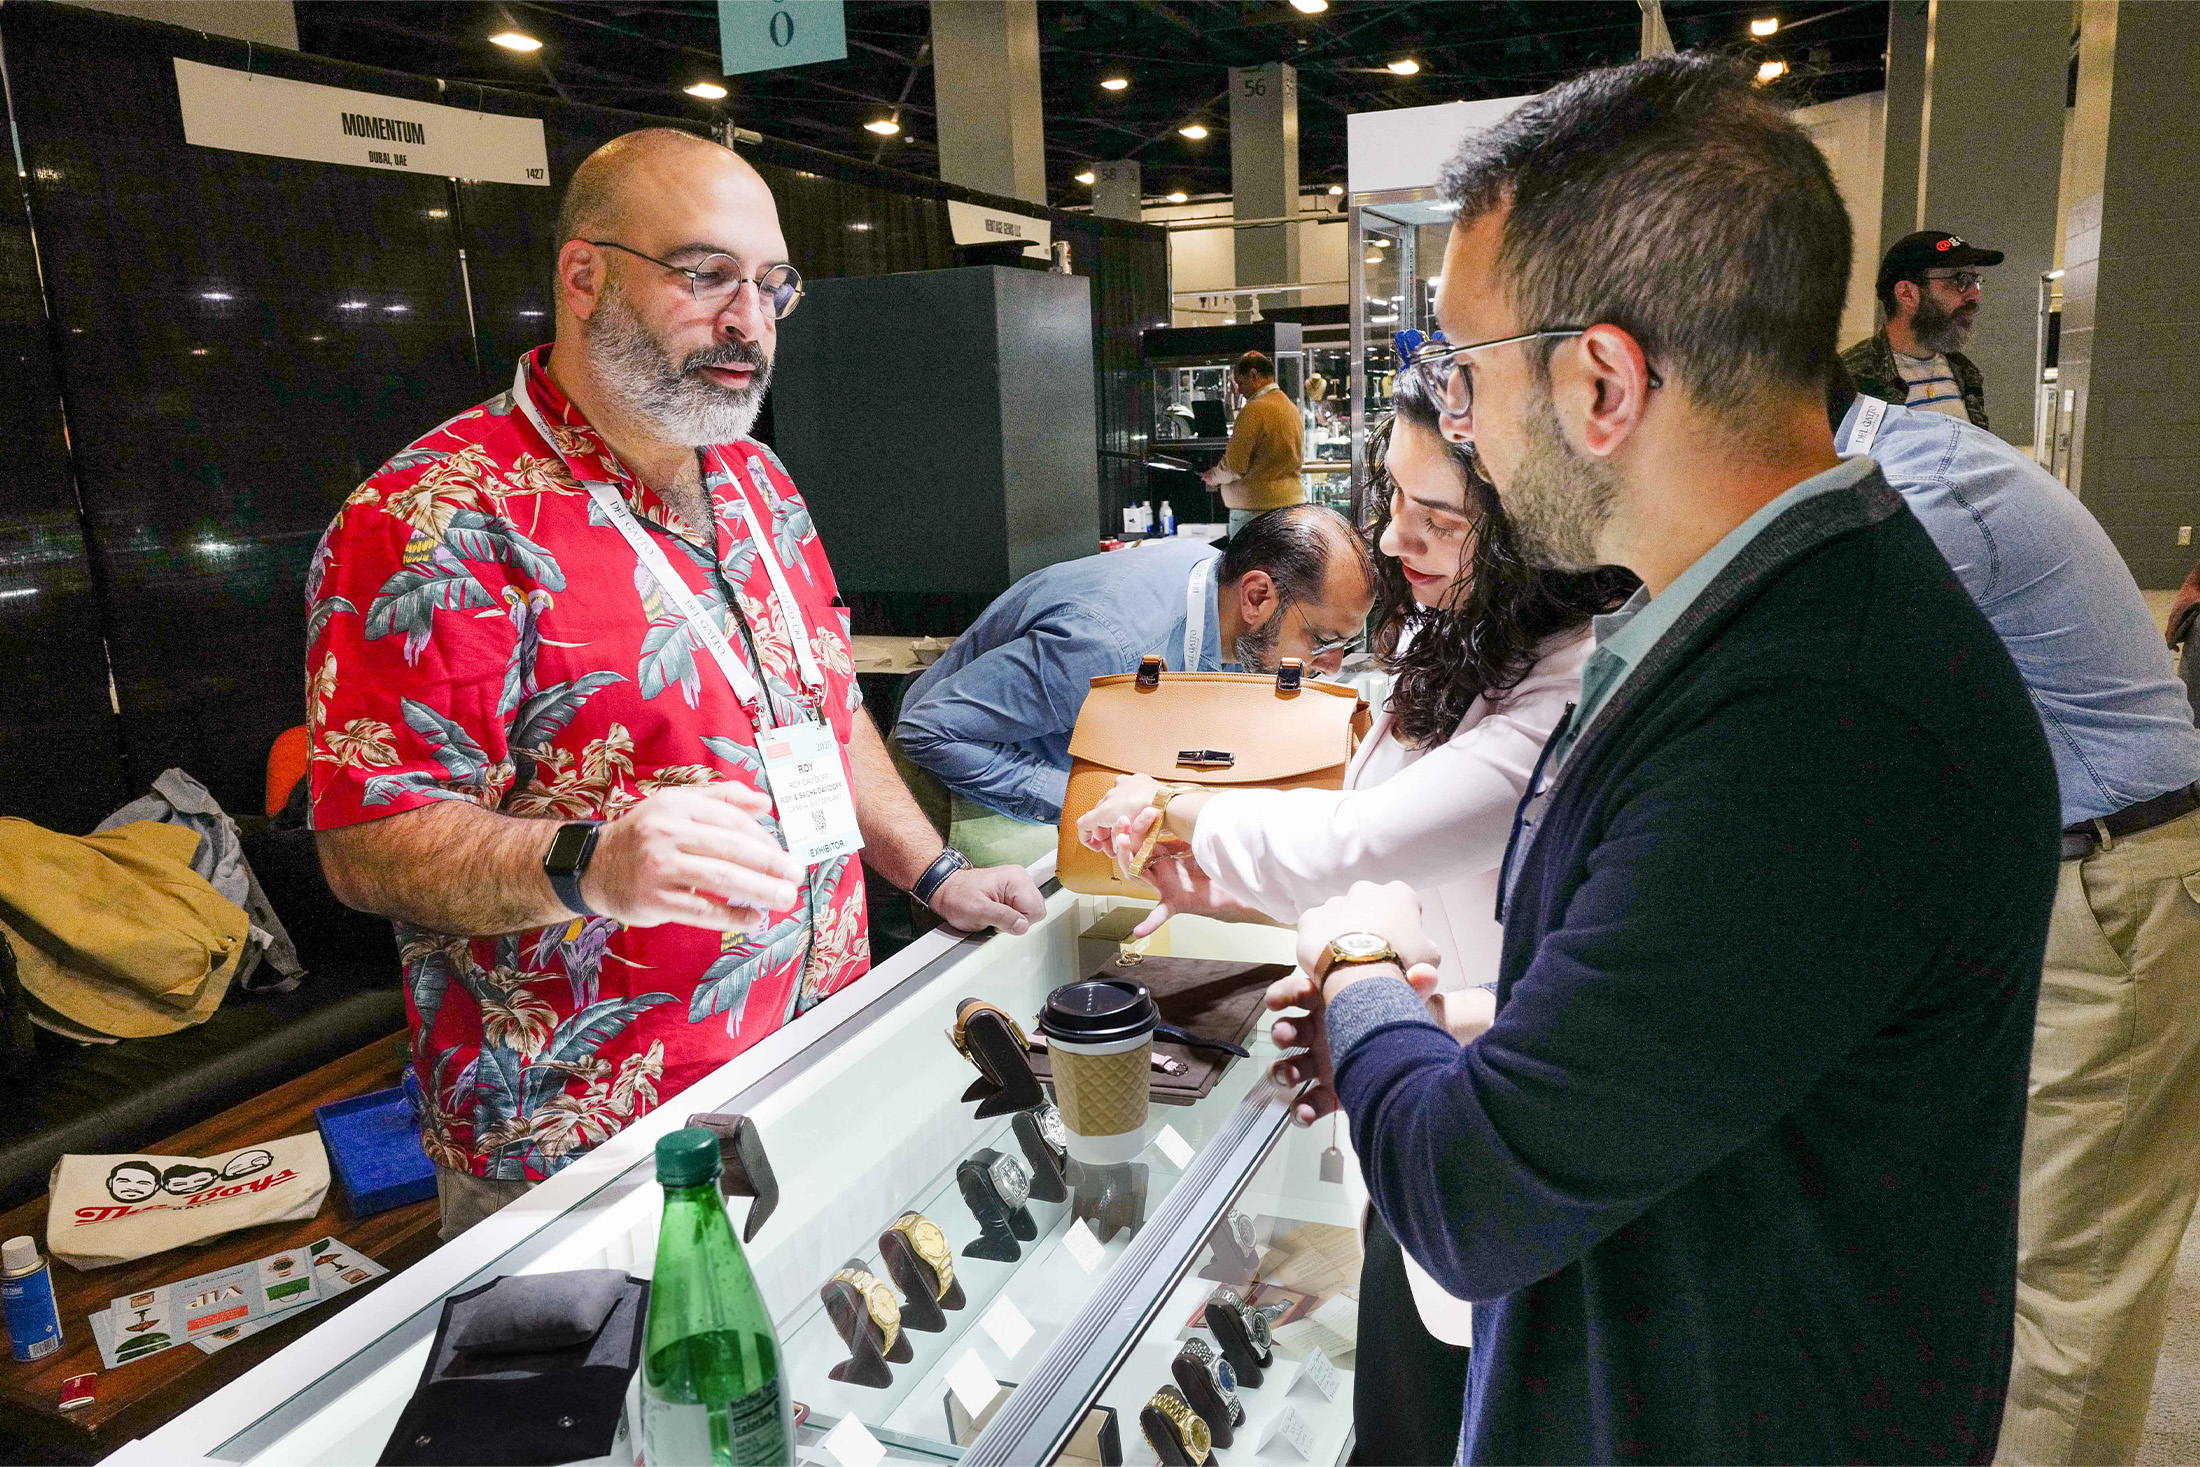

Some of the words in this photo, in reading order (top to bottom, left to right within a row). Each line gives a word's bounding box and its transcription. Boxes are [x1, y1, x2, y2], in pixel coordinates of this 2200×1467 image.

[1244, 78, 1266, 98] 56
[341, 112, 425, 145] MOMENTUM
[368, 151, 393, 167] DUBAI,
[394, 153, 408, 167] UAE
[525, 168, 544, 180] 1427
[1856, 429, 1868, 443] DEL
[1863, 405, 1877, 428] GATTO
[610, 500, 627, 519] DEL
[625, 522, 654, 555] GATTO
[684, 599, 701, 617] DEL
[700, 619, 726, 655] GATTO
[816, 740, 832, 752] 2025
[797, 762, 814, 774] ROY
[780, 794, 792, 805] ROY
[794, 793, 799, 802] &
[799, 789, 818, 801] SACHA
[817, 781, 842, 796] DAVIDOFF
[809, 839, 845, 858] EXHIBITOR
[184, 1168, 301, 1205] Boys
[184, 1285, 245, 1310] VIP
